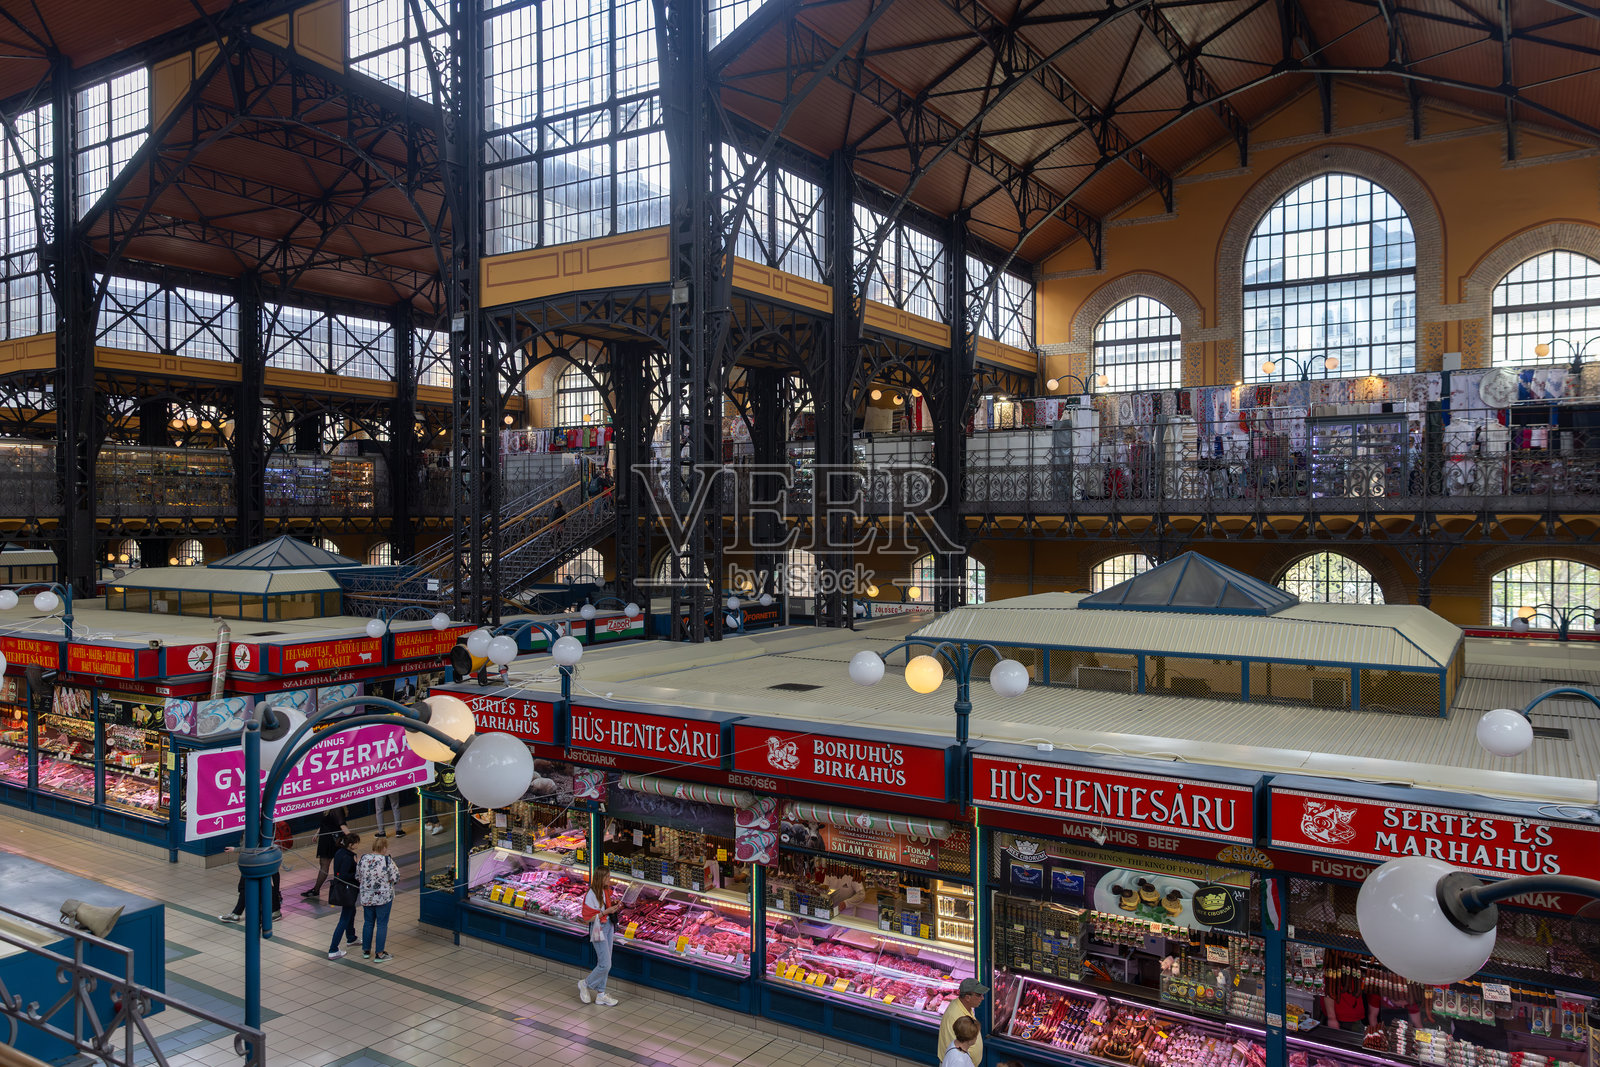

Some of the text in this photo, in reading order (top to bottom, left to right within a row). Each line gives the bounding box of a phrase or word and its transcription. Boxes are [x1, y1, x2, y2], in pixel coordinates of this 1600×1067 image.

[608, 618, 631, 630] ZÁDOR
[748, 611, 778, 621] FORNETTI
[472, 697, 539, 718] SERTÉS ÉS
[571, 711, 720, 760] HÚS-HENTESÁRU
[813, 738, 905, 766] BORJUHÚS
[331, 755, 405, 785] PHARMACY
[813, 758, 907, 786] BIRKAHÚS
[281, 798, 325, 813] KÖZRAKTÁR
[340, 785, 365, 800] MÁTYÁS
[375, 779, 397, 791] SAROK
[989, 763, 1237, 832] HÚS-HENTESÁRU
[1382, 807, 1554, 847] SERTÉS ÉS
[831, 841, 865, 856] SALAMI
[867, 848, 874, 857] &
[876, 849, 897, 862] HAM
[906, 845, 931, 856] TOKAJ
[1148, 835, 1180, 852] BEEF
[1374, 830, 1562, 875] MARHAHÚS
[909, 857, 928, 866] MEAT
[1020, 850, 1047, 862] CIBORUM
[1050, 844, 1203, 876] THE FOOD OF KINGS THE KING OF FOOD
[1207, 905, 1231, 917] CIBORUM
